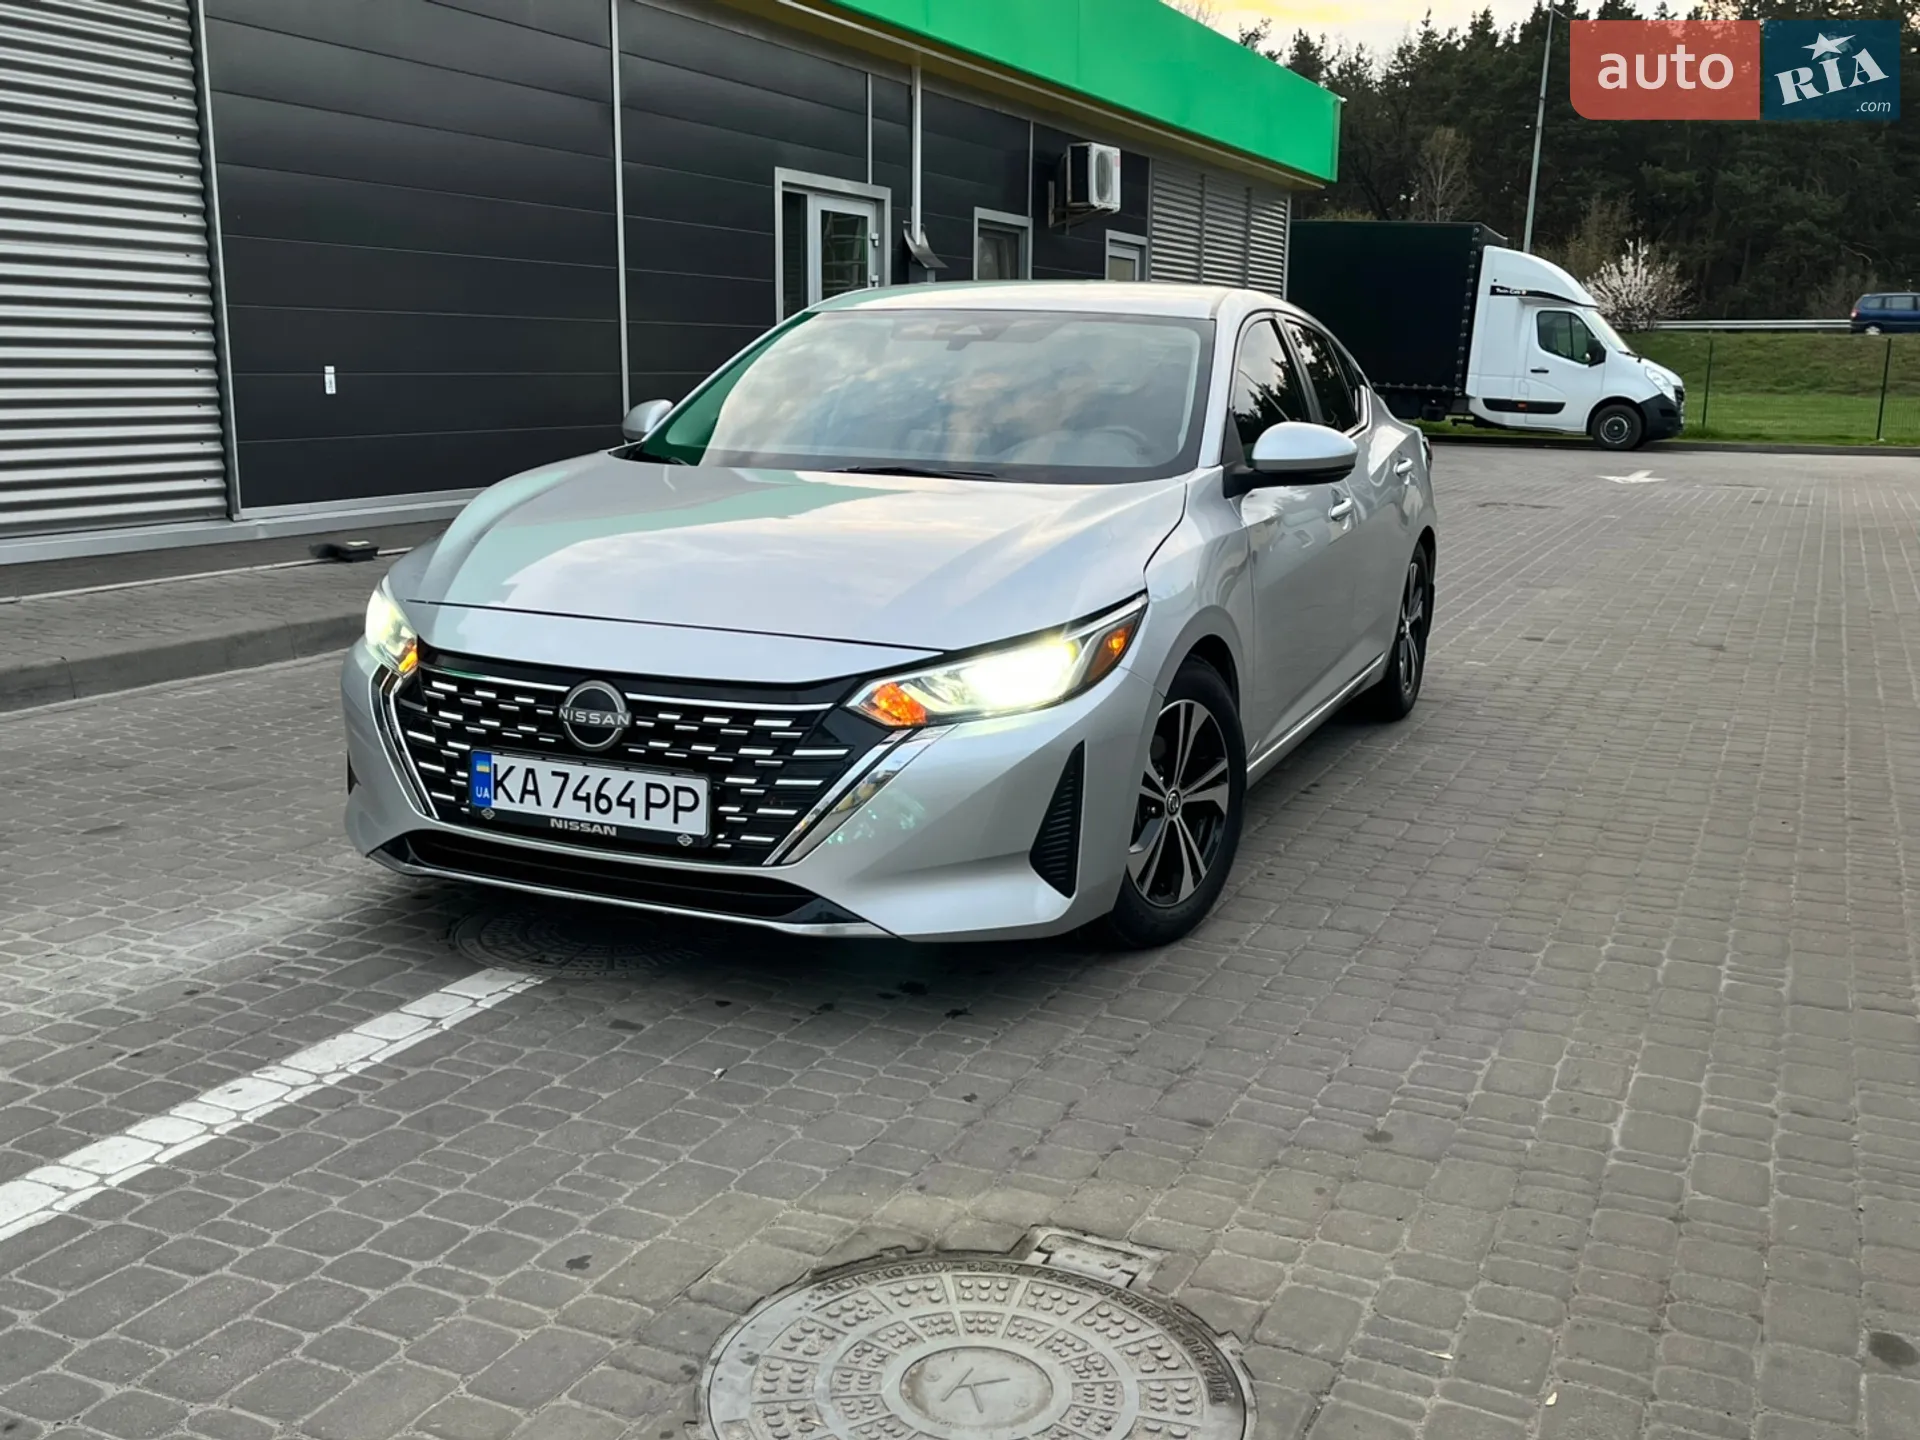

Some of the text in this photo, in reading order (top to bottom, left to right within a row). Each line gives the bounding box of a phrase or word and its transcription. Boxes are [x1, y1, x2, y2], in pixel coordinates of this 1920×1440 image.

[559, 708, 629, 726] NISSAN
[475, 786, 491, 800] UA
[550, 818, 618, 837] NISSAN
